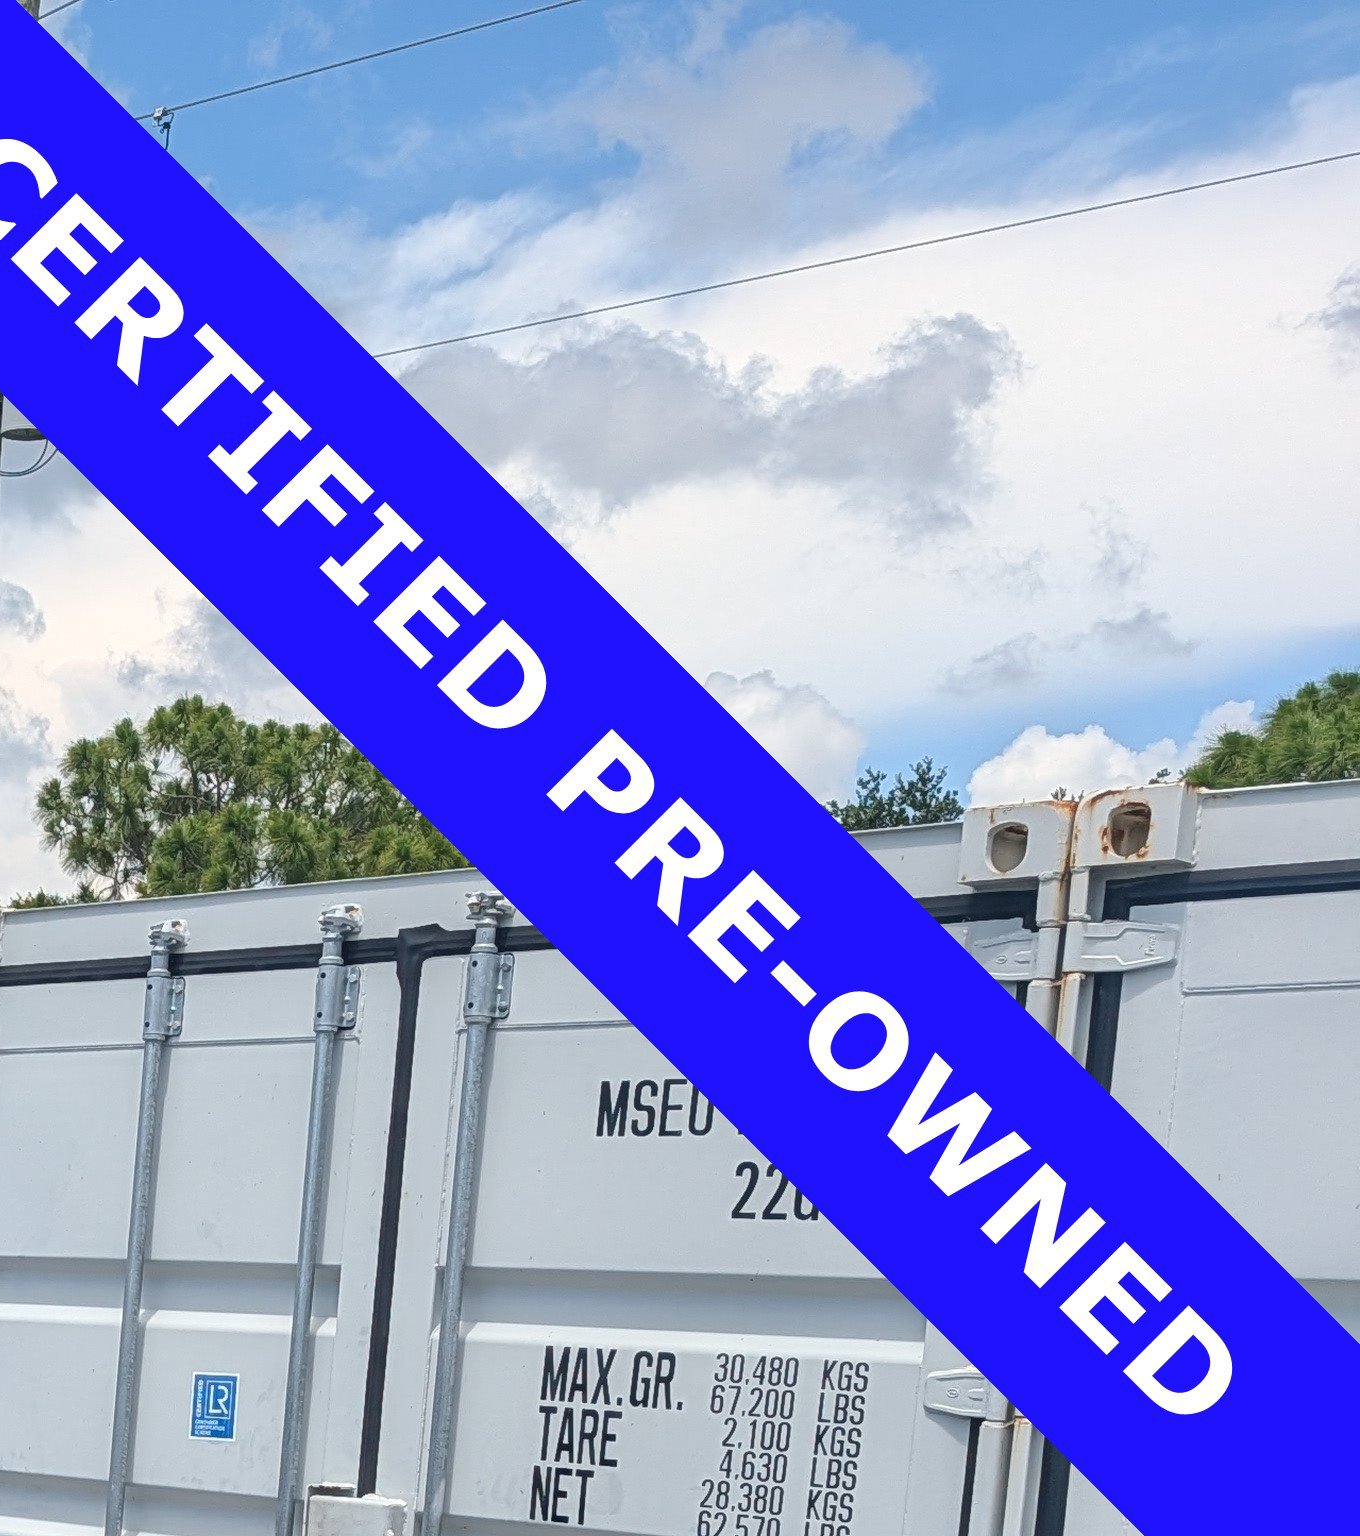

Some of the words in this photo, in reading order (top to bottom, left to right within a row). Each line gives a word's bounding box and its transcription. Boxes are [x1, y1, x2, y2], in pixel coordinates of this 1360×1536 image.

[596, 1078, 715, 1137] MSEU
[821, 1359, 870, 1393] KGS
[817, 1392, 866, 1425] LBS
[539, 1405, 623, 1468] TARE
[813, 1425, 862, 1458] KGS
[529, 1465, 595, 1526] NET
[806, 1489, 854, 1523] KGS
[809, 1457, 858, 1491] LBS
